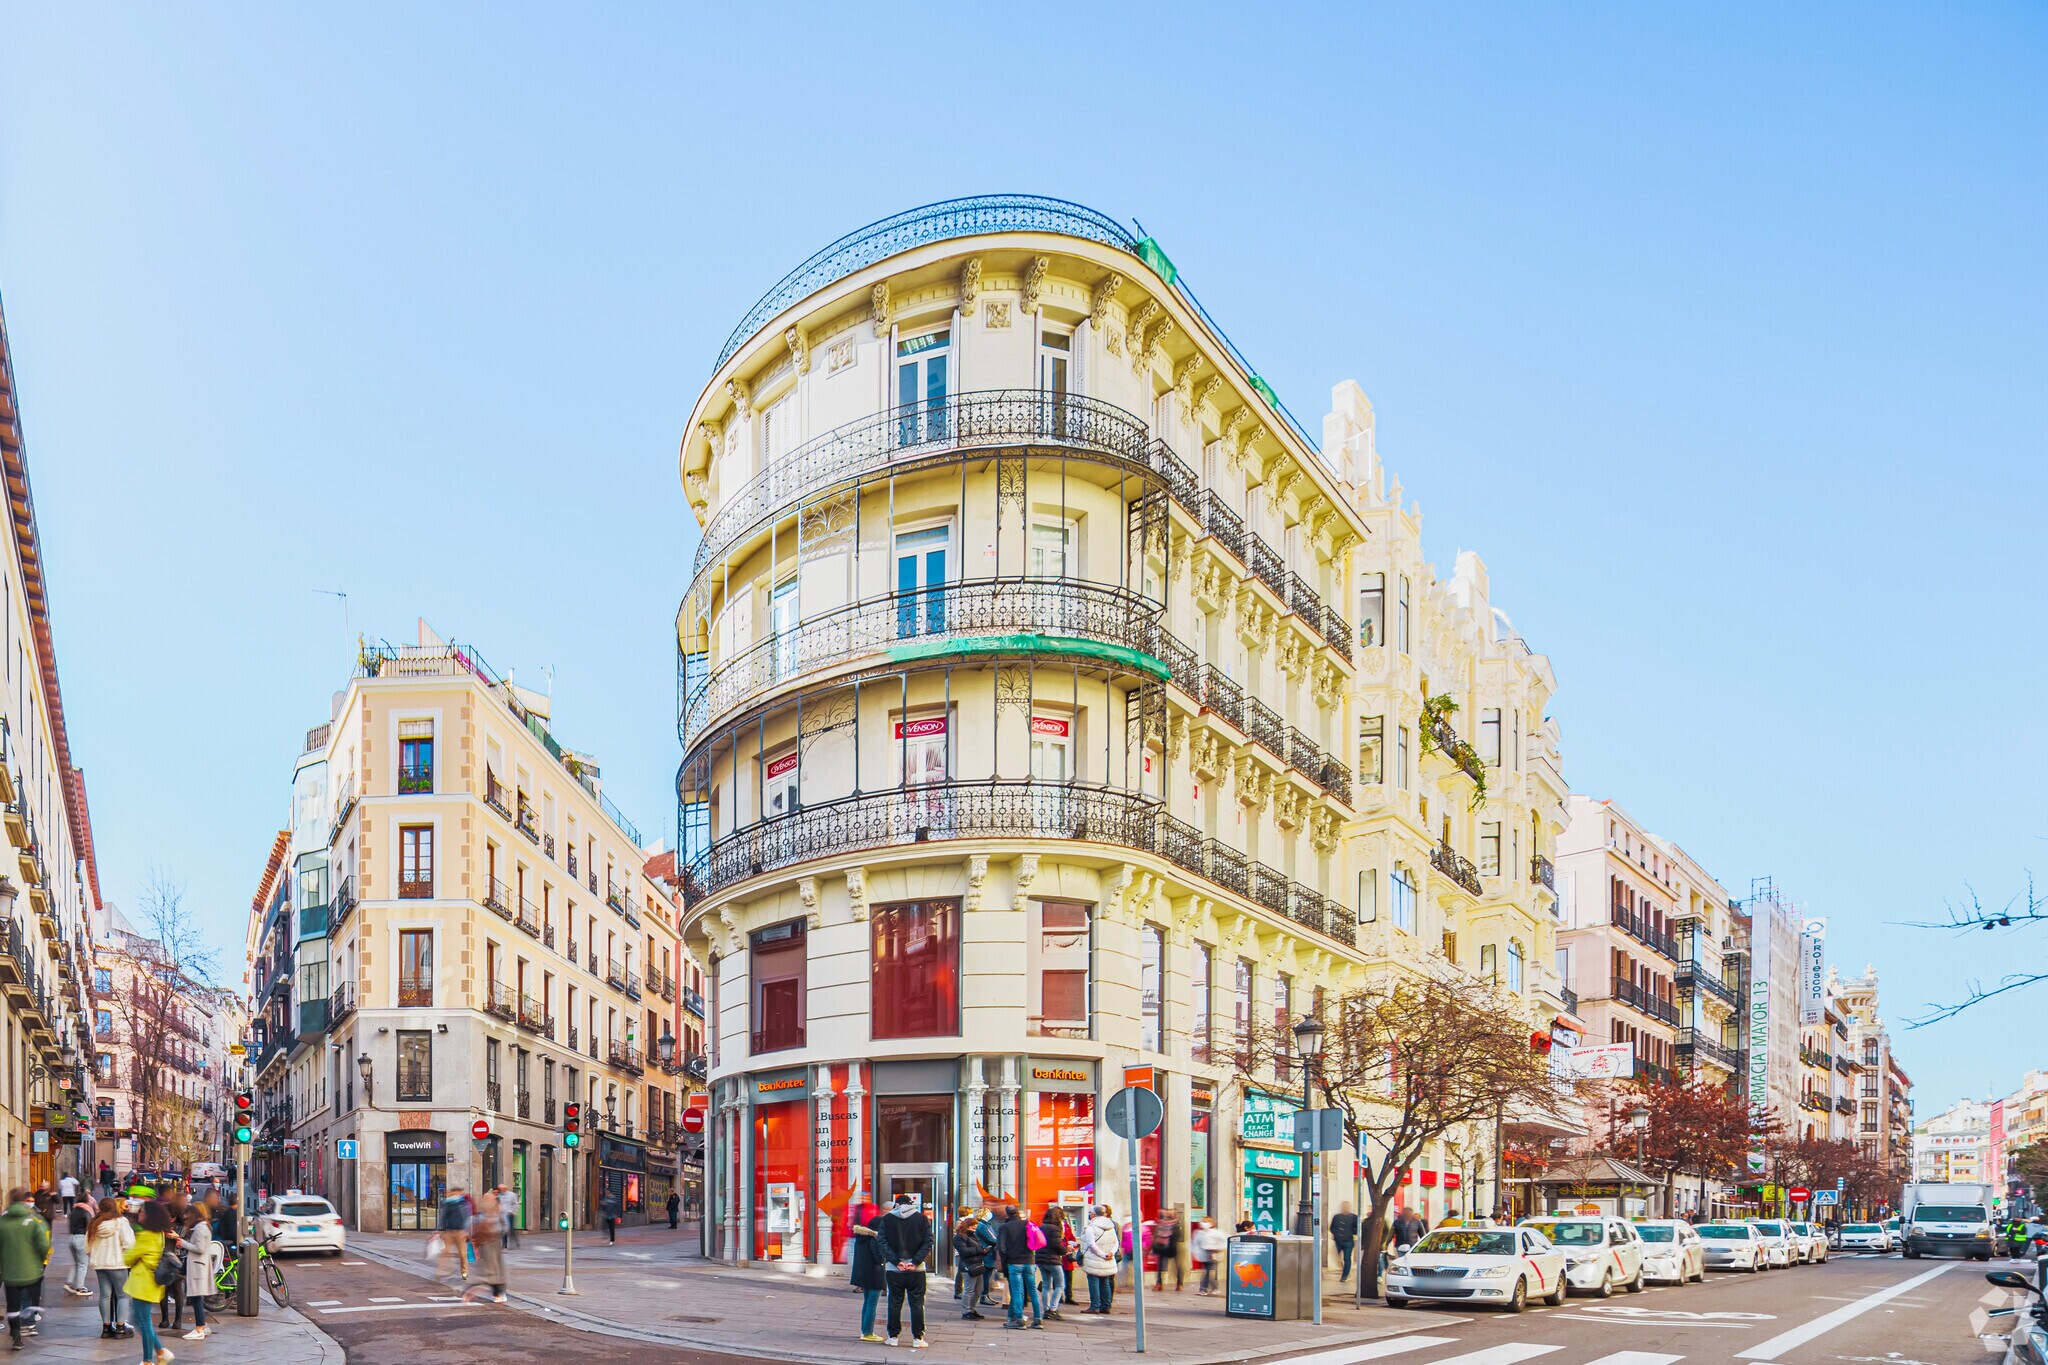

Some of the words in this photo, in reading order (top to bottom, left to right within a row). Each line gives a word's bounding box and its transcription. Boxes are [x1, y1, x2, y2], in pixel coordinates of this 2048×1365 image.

[903, 722, 939, 734] SVENSON
[1033, 721, 1061, 732] SVENSON
[773, 758, 797, 773] SVENSON
[1752, 981, 1768, 996] 13
[1751, 1001, 1768, 1047] MAYOR
[1033, 1068, 1087, 1081] bankinter
[758, 1079, 805, 1092] bankinter
[815, 1111, 858, 1121] ¿Buscas
[973, 1106, 1020, 1117] ¿Buscas
[1244, 1113, 1274, 1123] ATM
[973, 1133, 1015, 1146] cajero?
[1244, 1130, 1274, 1138] CHANGE
[815, 1137, 853, 1149] cajero?
[815, 1156, 845, 1164] Looking
[973, 1155, 1007, 1164] Looking
[1256, 1153, 1295, 1174] exchange
[825, 1165, 847, 1173] ATM?
